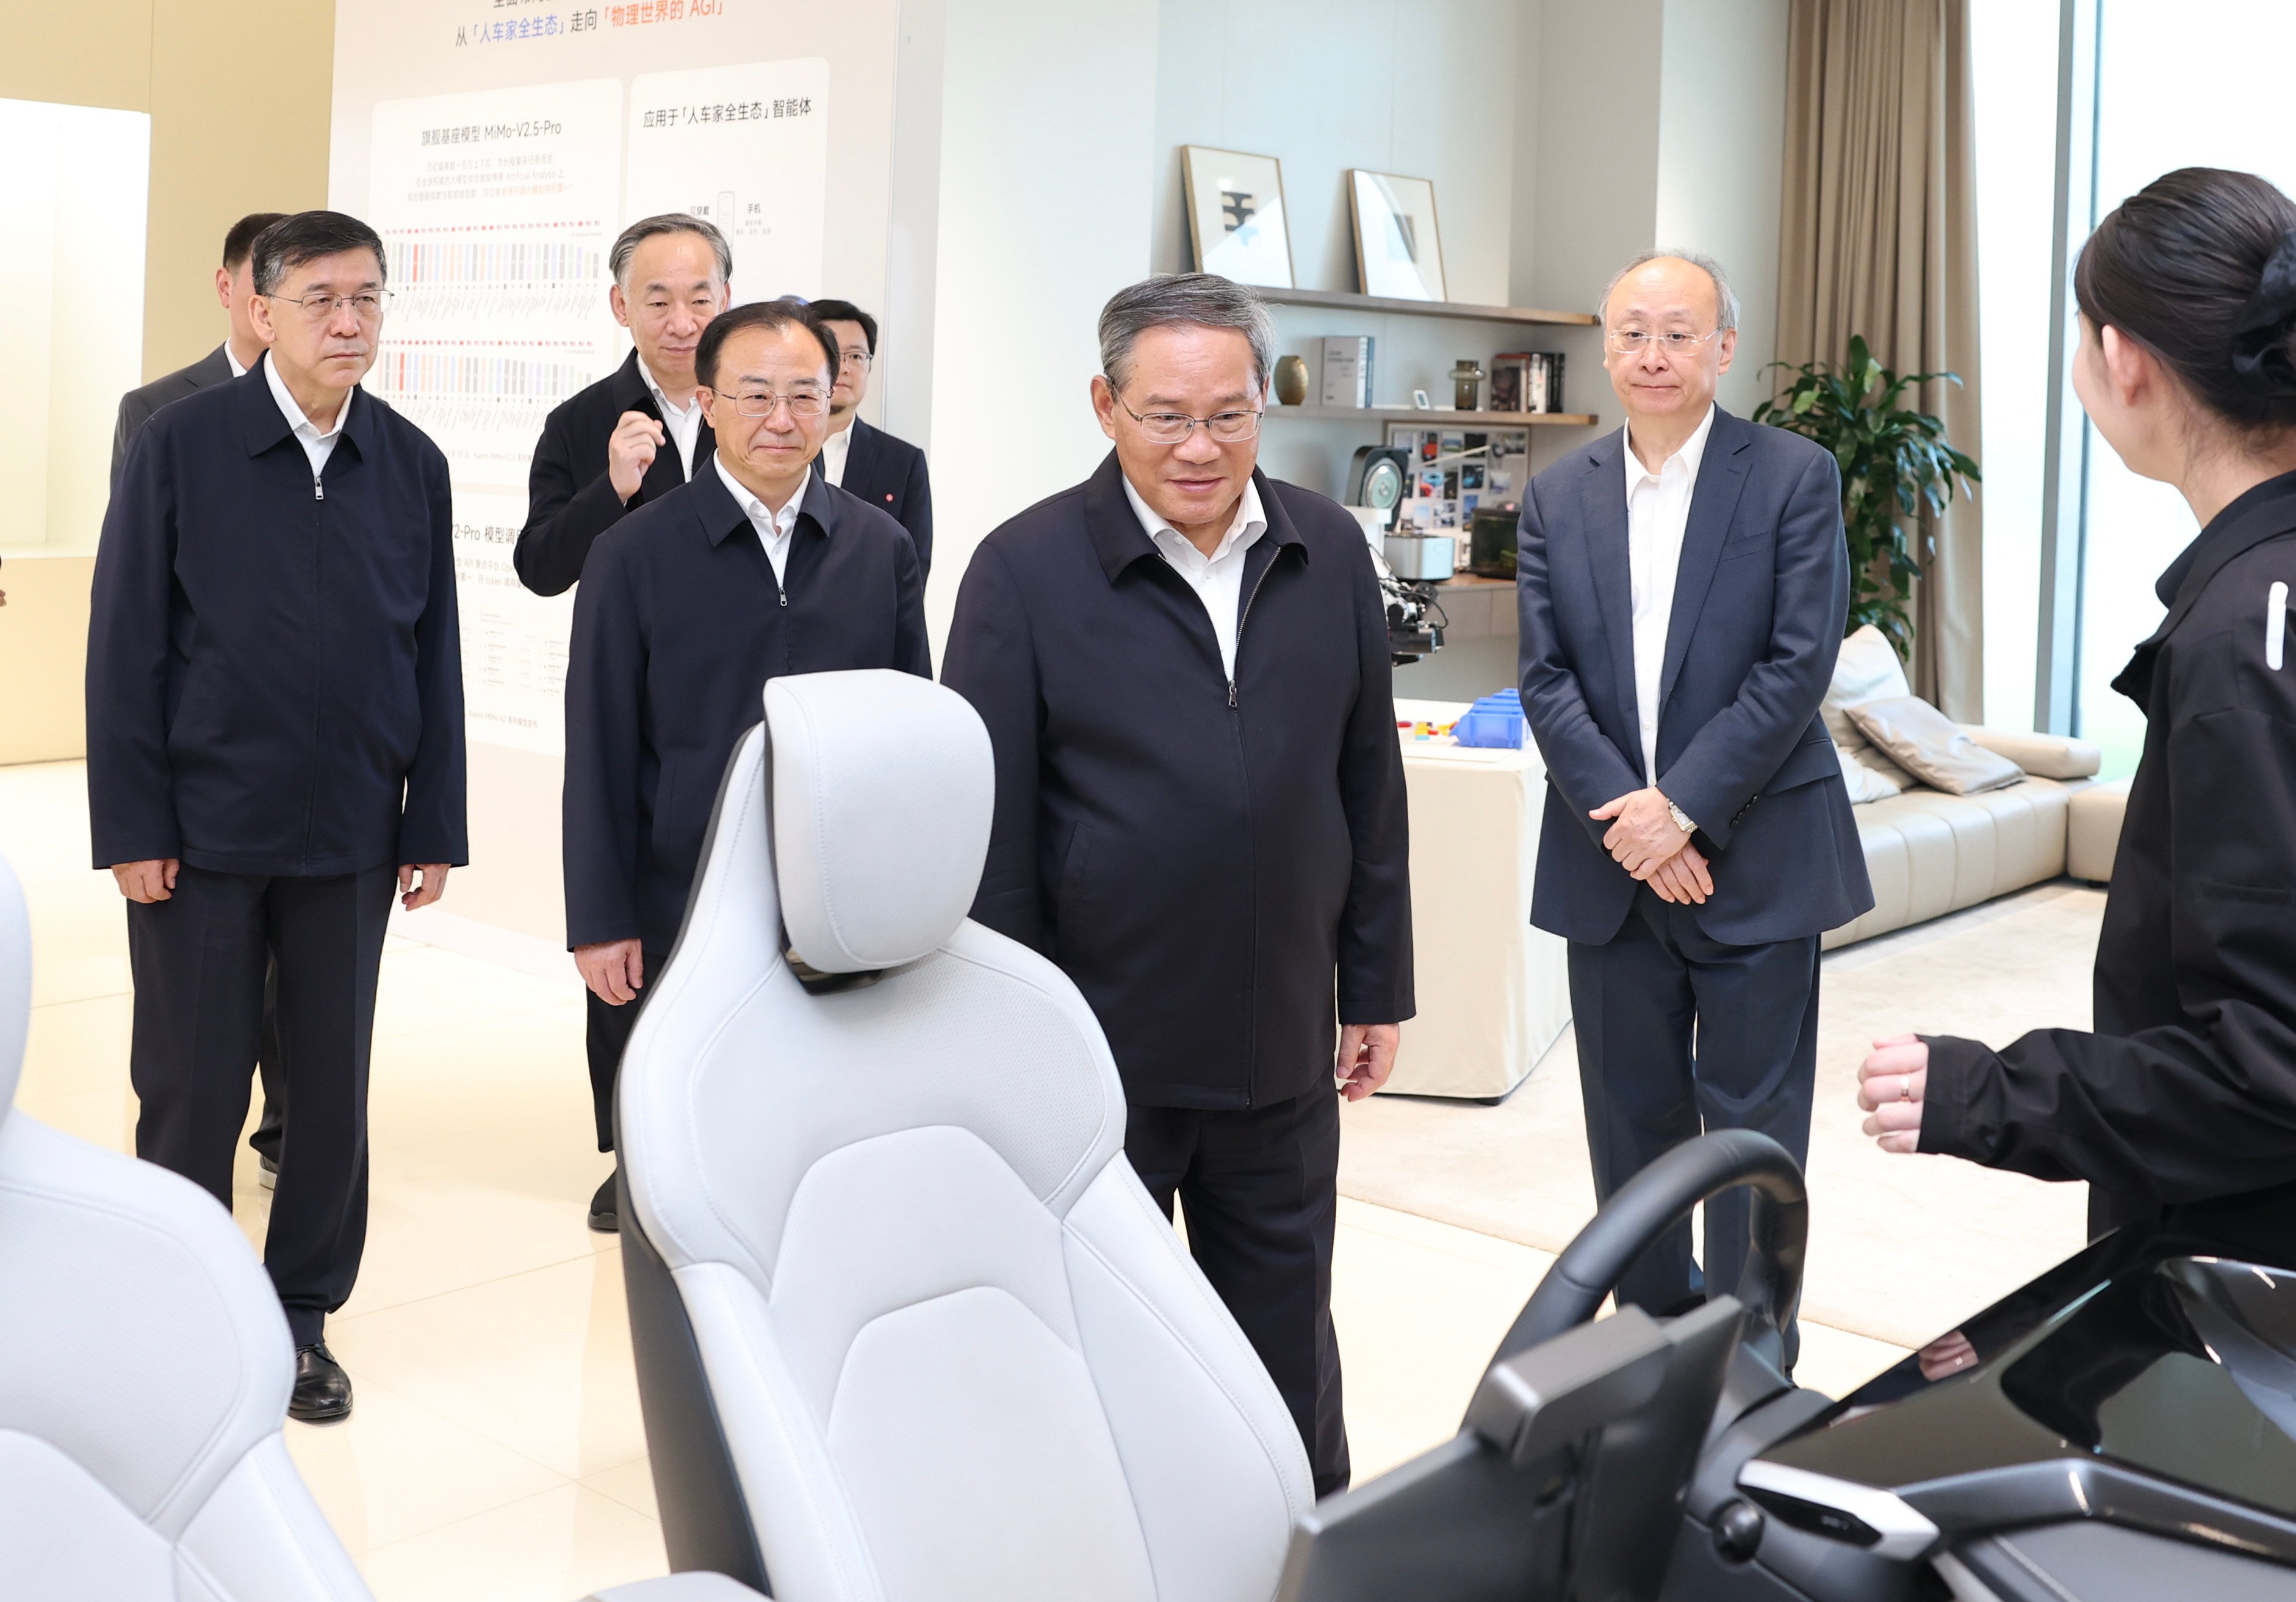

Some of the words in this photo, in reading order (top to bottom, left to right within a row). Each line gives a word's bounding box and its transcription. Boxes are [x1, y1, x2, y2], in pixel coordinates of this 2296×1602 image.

[643, 96, 812, 128] 应用于「人车家全生态」智能体
[422, 125, 480, 146] 旗舰基座模型
[484, 120, 562, 140] MiMo-V2.5-Pro
[747, 203, 761, 214] 手机
[452, 524, 481, 541] 2-Pro
